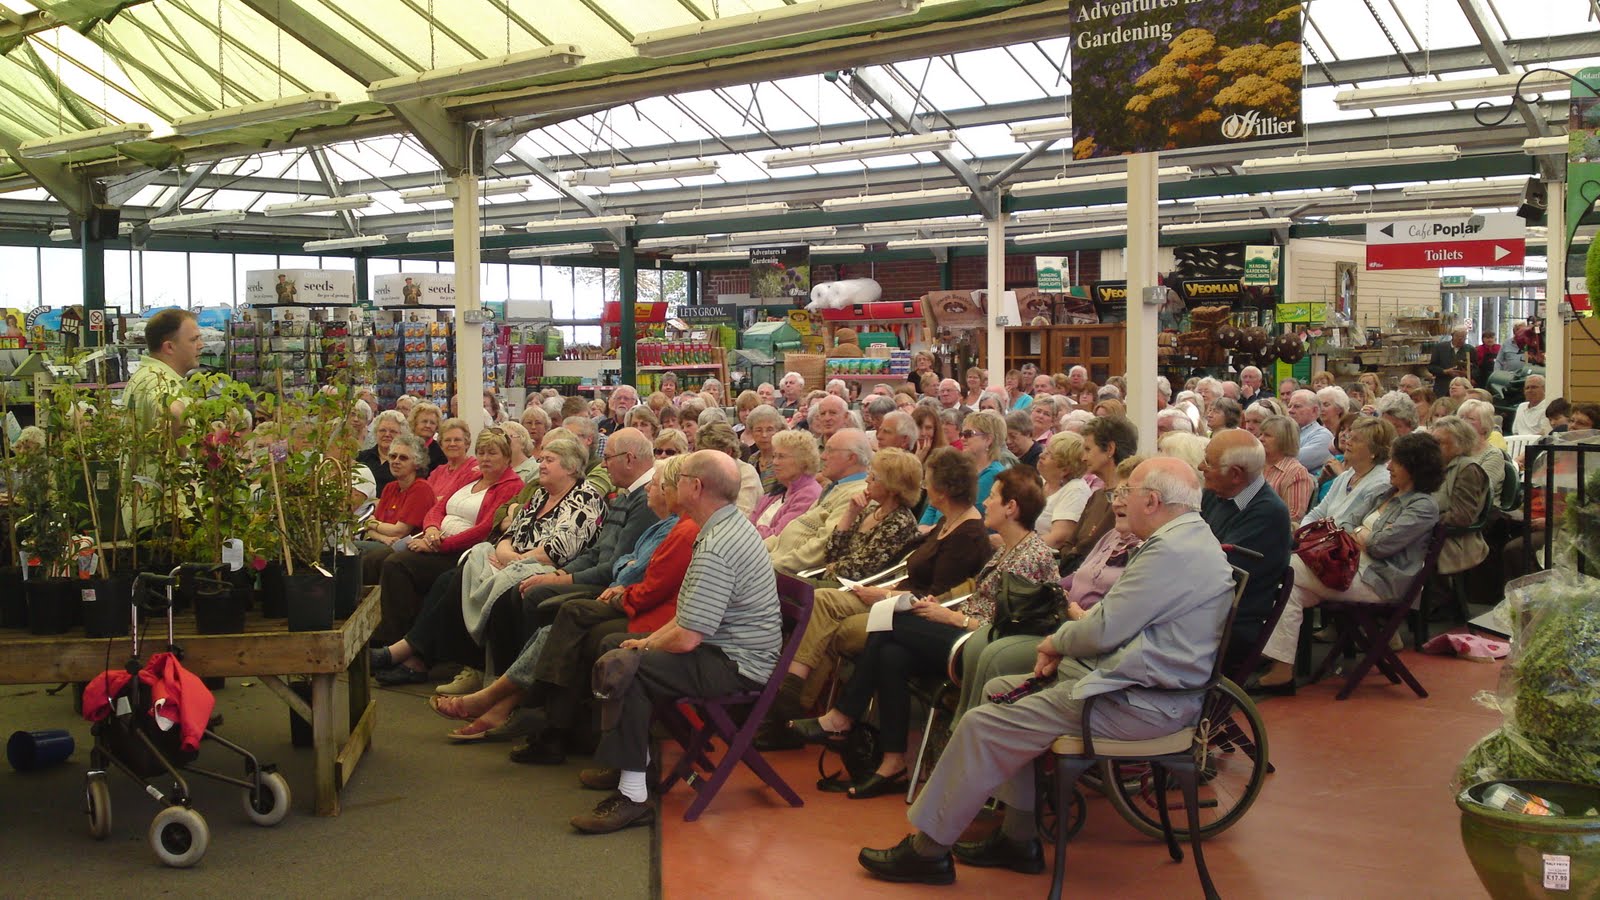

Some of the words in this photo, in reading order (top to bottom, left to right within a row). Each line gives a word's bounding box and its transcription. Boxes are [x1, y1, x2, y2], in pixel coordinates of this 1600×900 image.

[1077, 21, 1173, 50] Gardening
[1221, 110, 1296, 139] Hillier
[1408, 222, 1432, 239] Café
[1432, 222, 1481, 238] Poplar
[780, 247, 787, 255] in
[1424, 249, 1464, 261] Toilets
[751, 257, 779, 265] Gardening
[247, 281, 264, 292] seeds
[303, 280, 334, 291] seeds
[374, 284, 391, 295] seeds
[428, 284, 455, 294] seeds
[1185, 283, 1239, 297] YEOMAN
[1100, 287, 1128, 301] YEO
[26, 305, 50, 331] SUTTONS
